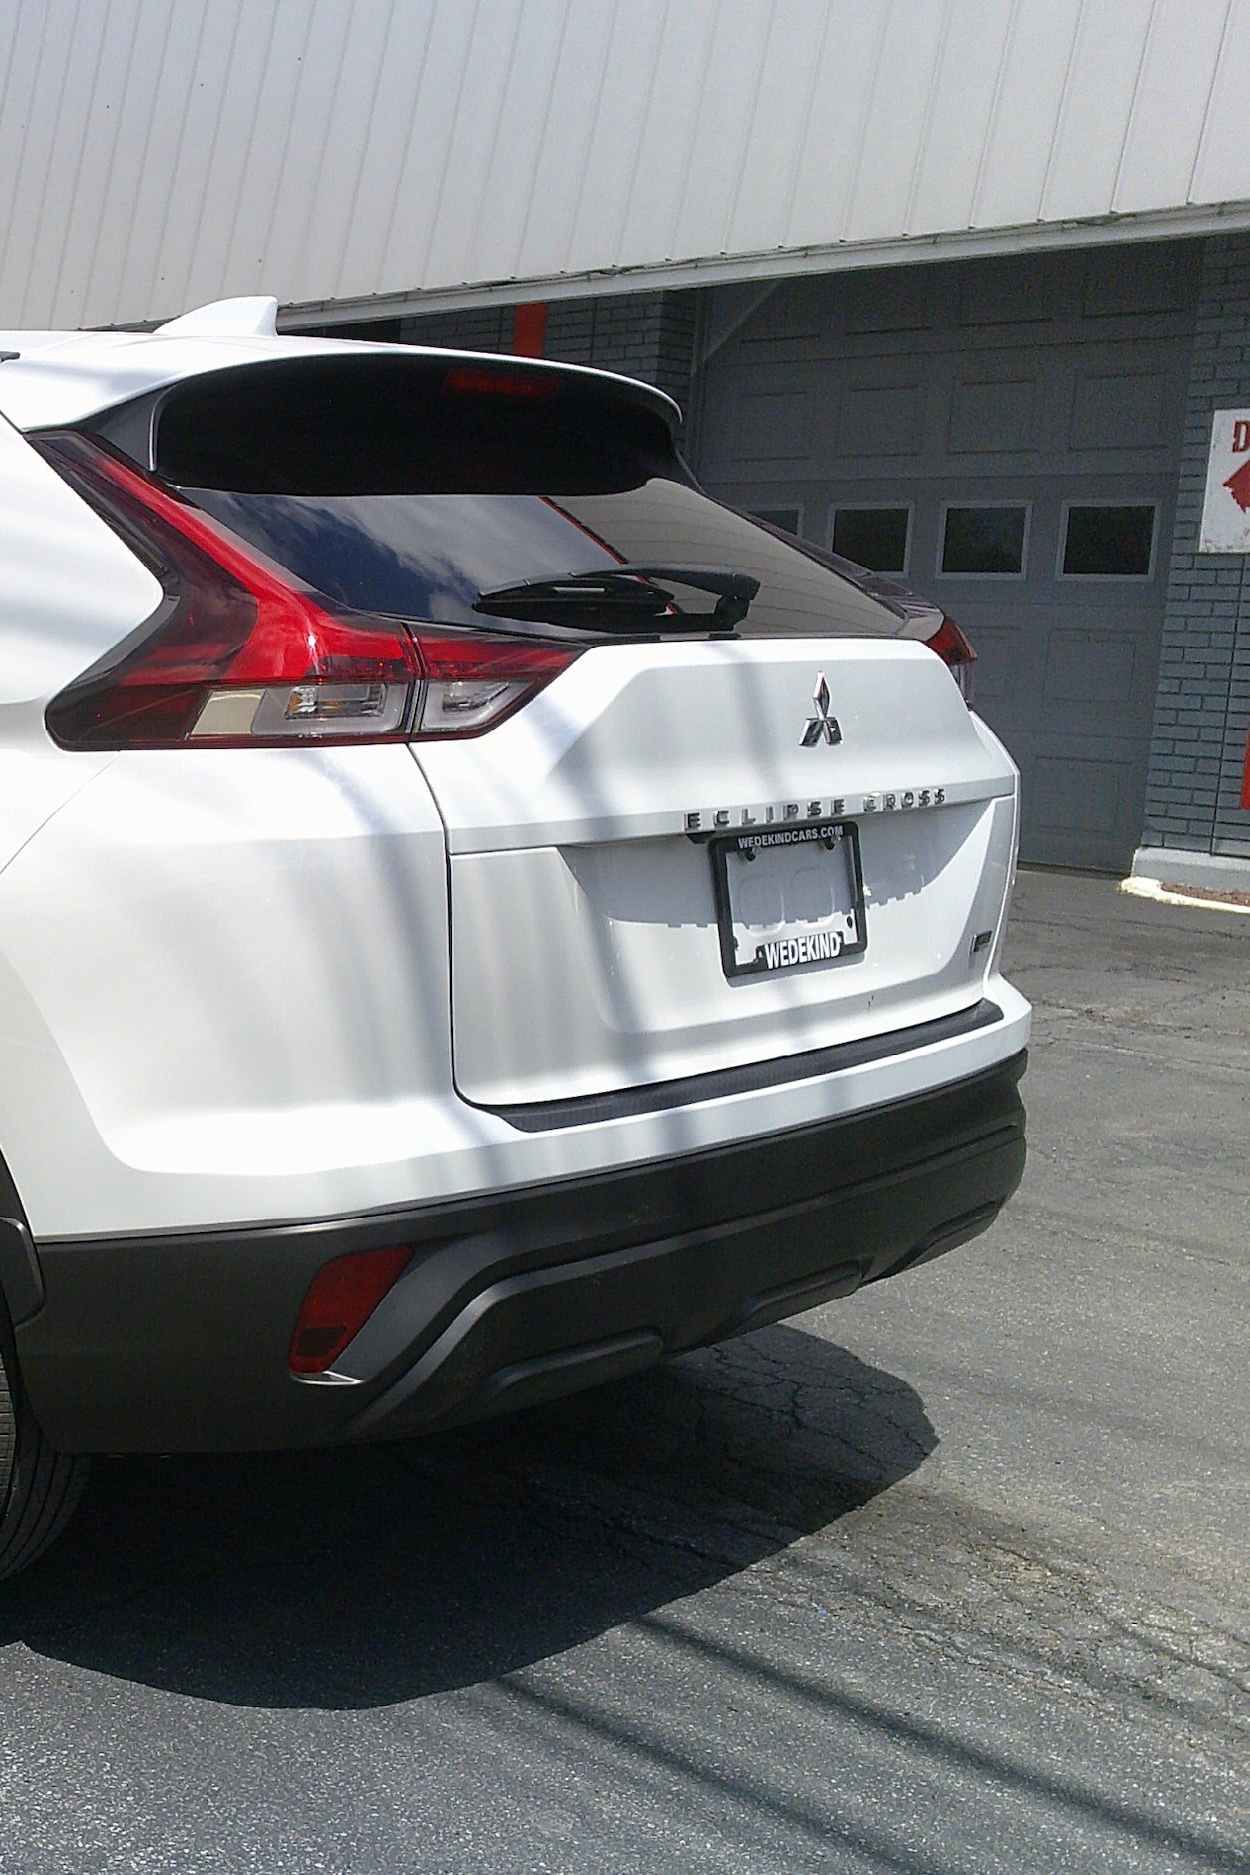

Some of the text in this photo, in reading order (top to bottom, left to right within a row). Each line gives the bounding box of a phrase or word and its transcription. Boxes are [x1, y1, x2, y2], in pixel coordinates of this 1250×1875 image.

[683, 788, 946, 832] ECLIPSE CROSS
[737, 825, 844, 850] WEDEKINDCARS.COM
[764, 931, 842, 970] WEDEKIND
